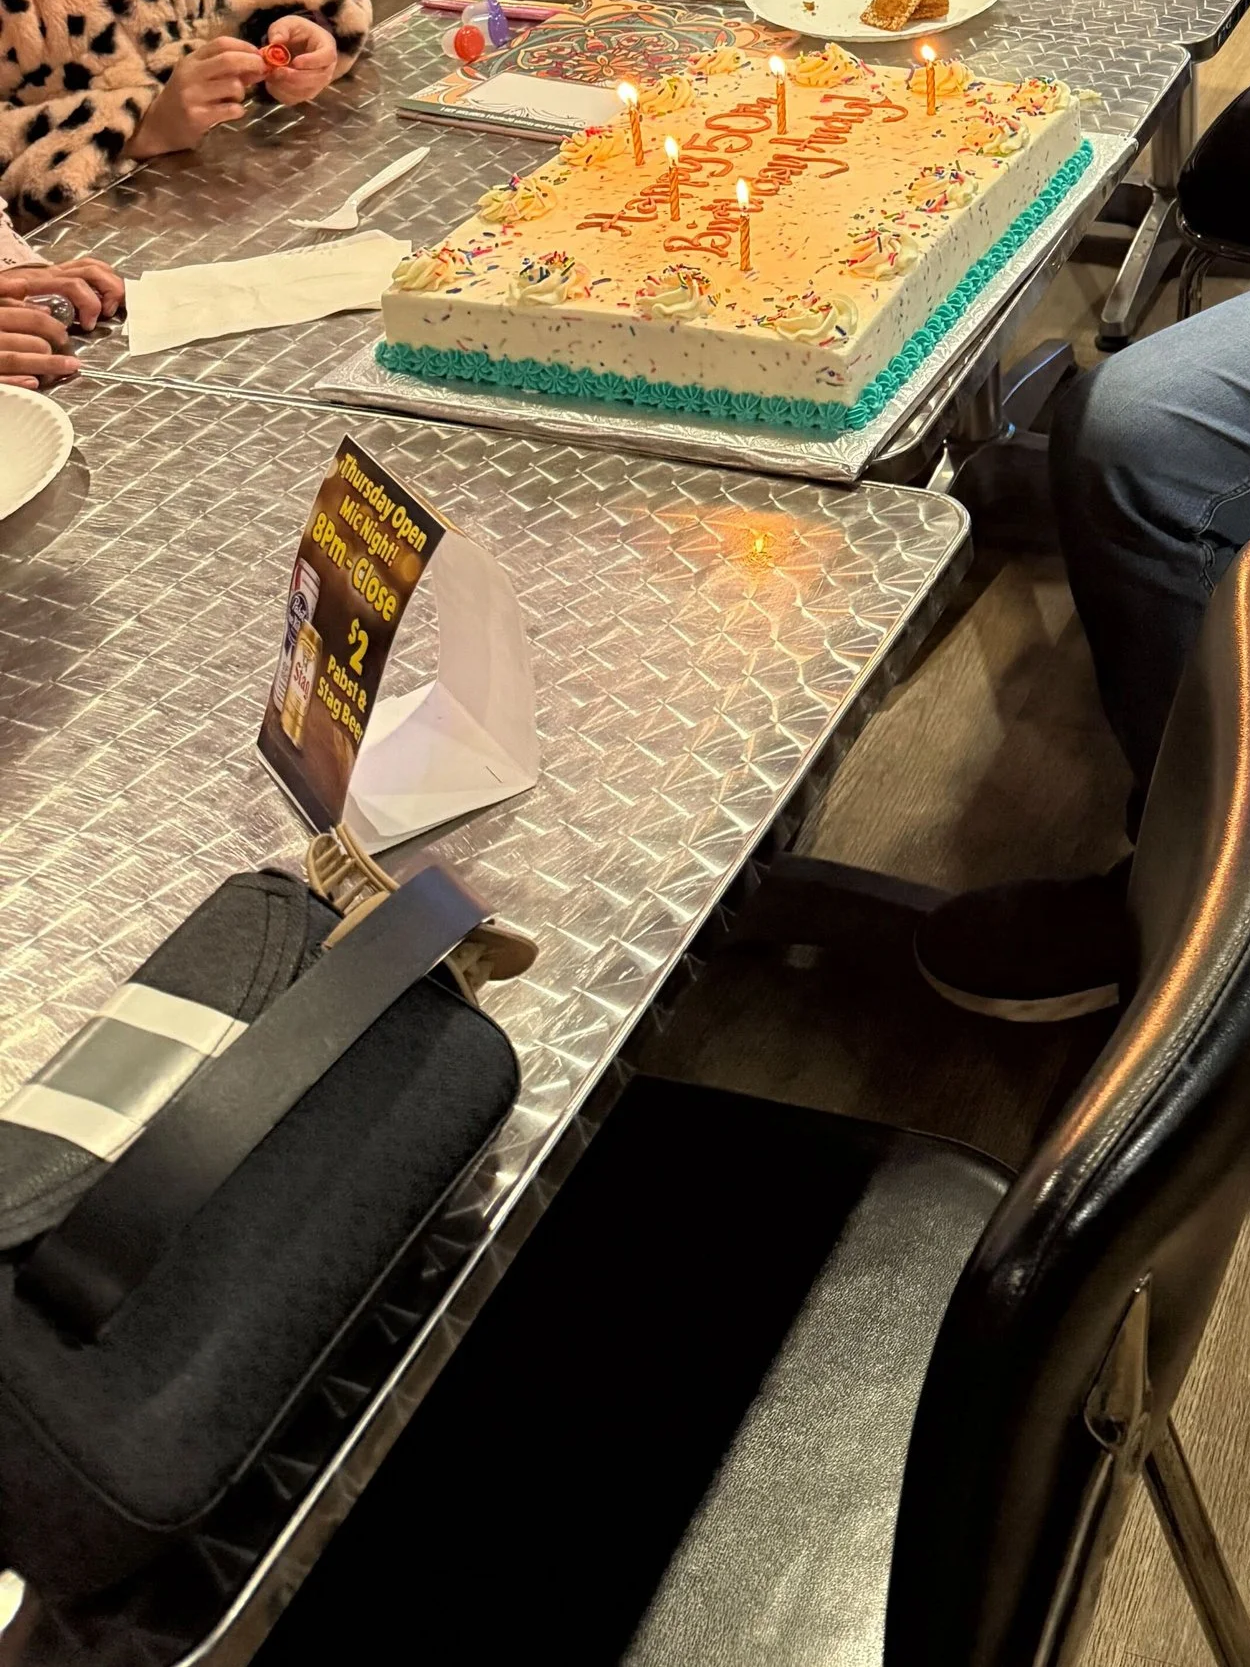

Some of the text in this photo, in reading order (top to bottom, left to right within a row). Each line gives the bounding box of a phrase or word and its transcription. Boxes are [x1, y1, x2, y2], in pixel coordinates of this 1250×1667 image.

[576, 154, 734, 237] Happy
[664, 153, 850, 259] Birthday
[338, 452, 428, 552] Thursday Open
[339, 497, 401, 567] Mic Night!
[311, 512, 346, 569] 8Pm
[351, 556, 398, 622] Close
[294, 661, 311, 700] Stag
[347, 617, 370, 676] $2
[316, 680, 364, 745] Stag Beer
[326, 654, 368, 714] Pabst &
